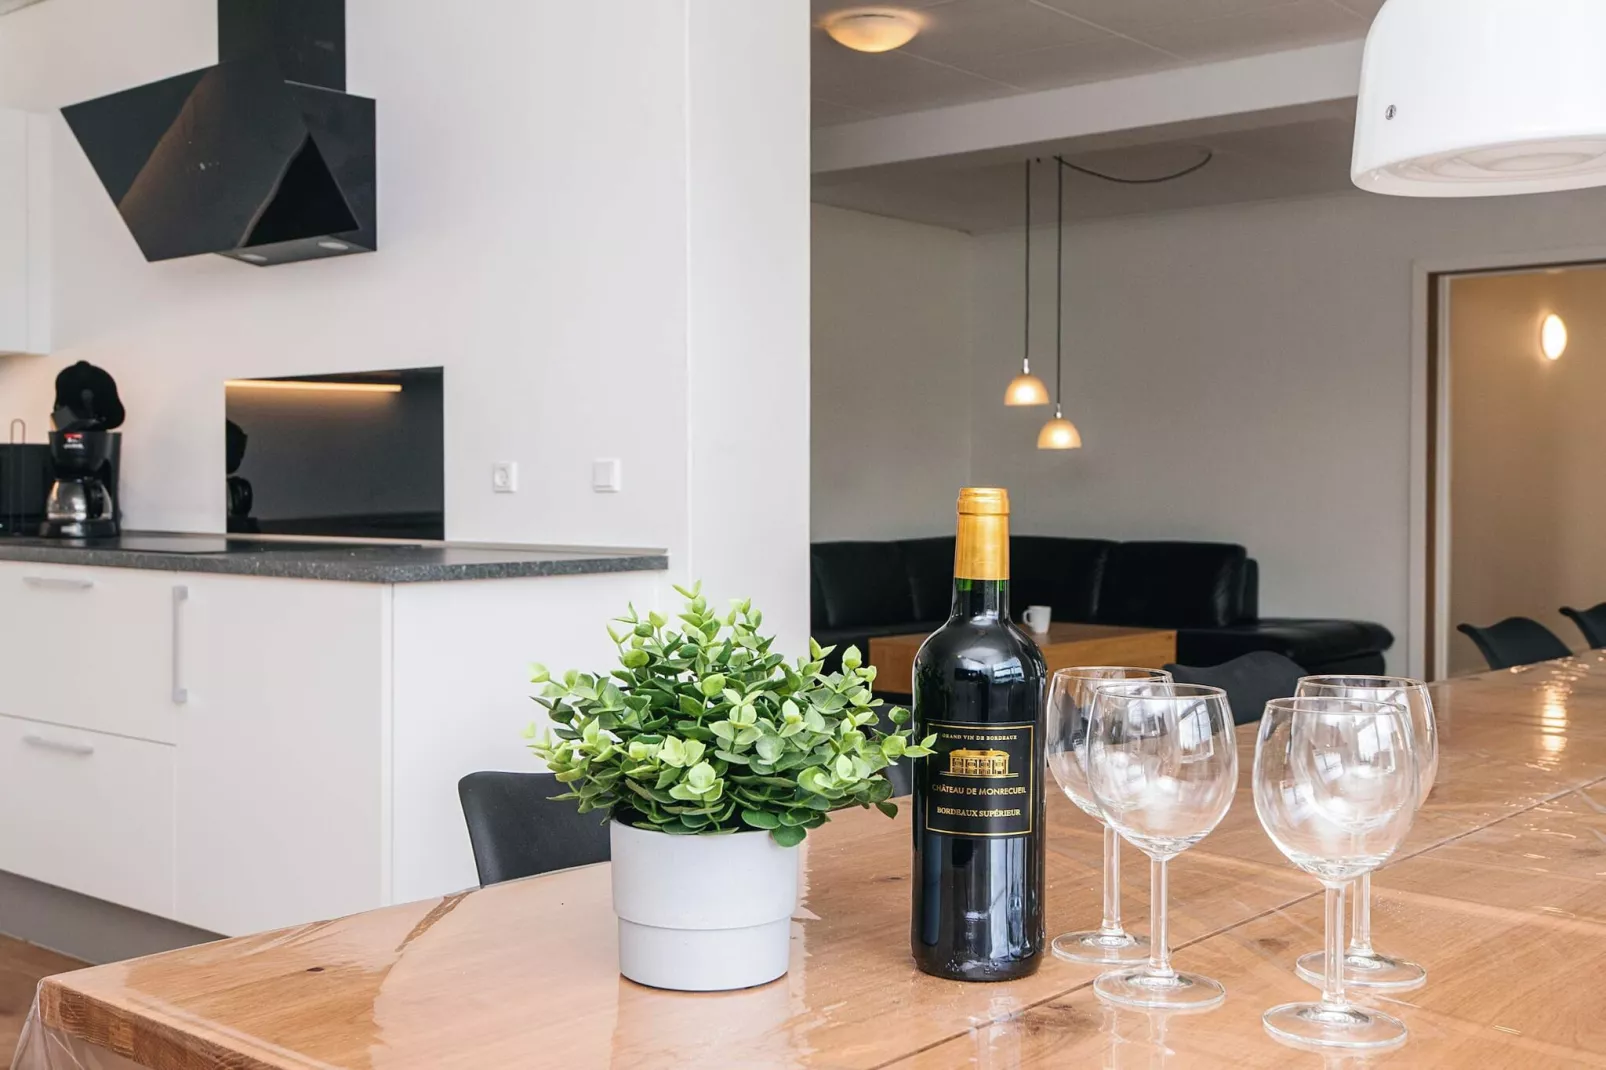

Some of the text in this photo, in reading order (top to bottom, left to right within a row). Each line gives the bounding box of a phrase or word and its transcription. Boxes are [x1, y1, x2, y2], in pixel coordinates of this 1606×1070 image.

[932, 783, 964, 794] CHÂTEAU
[978, 786, 1026, 796] MONRECUEIL
[937, 806, 1021, 818] BORDEAUX SUPÉRIEUR
